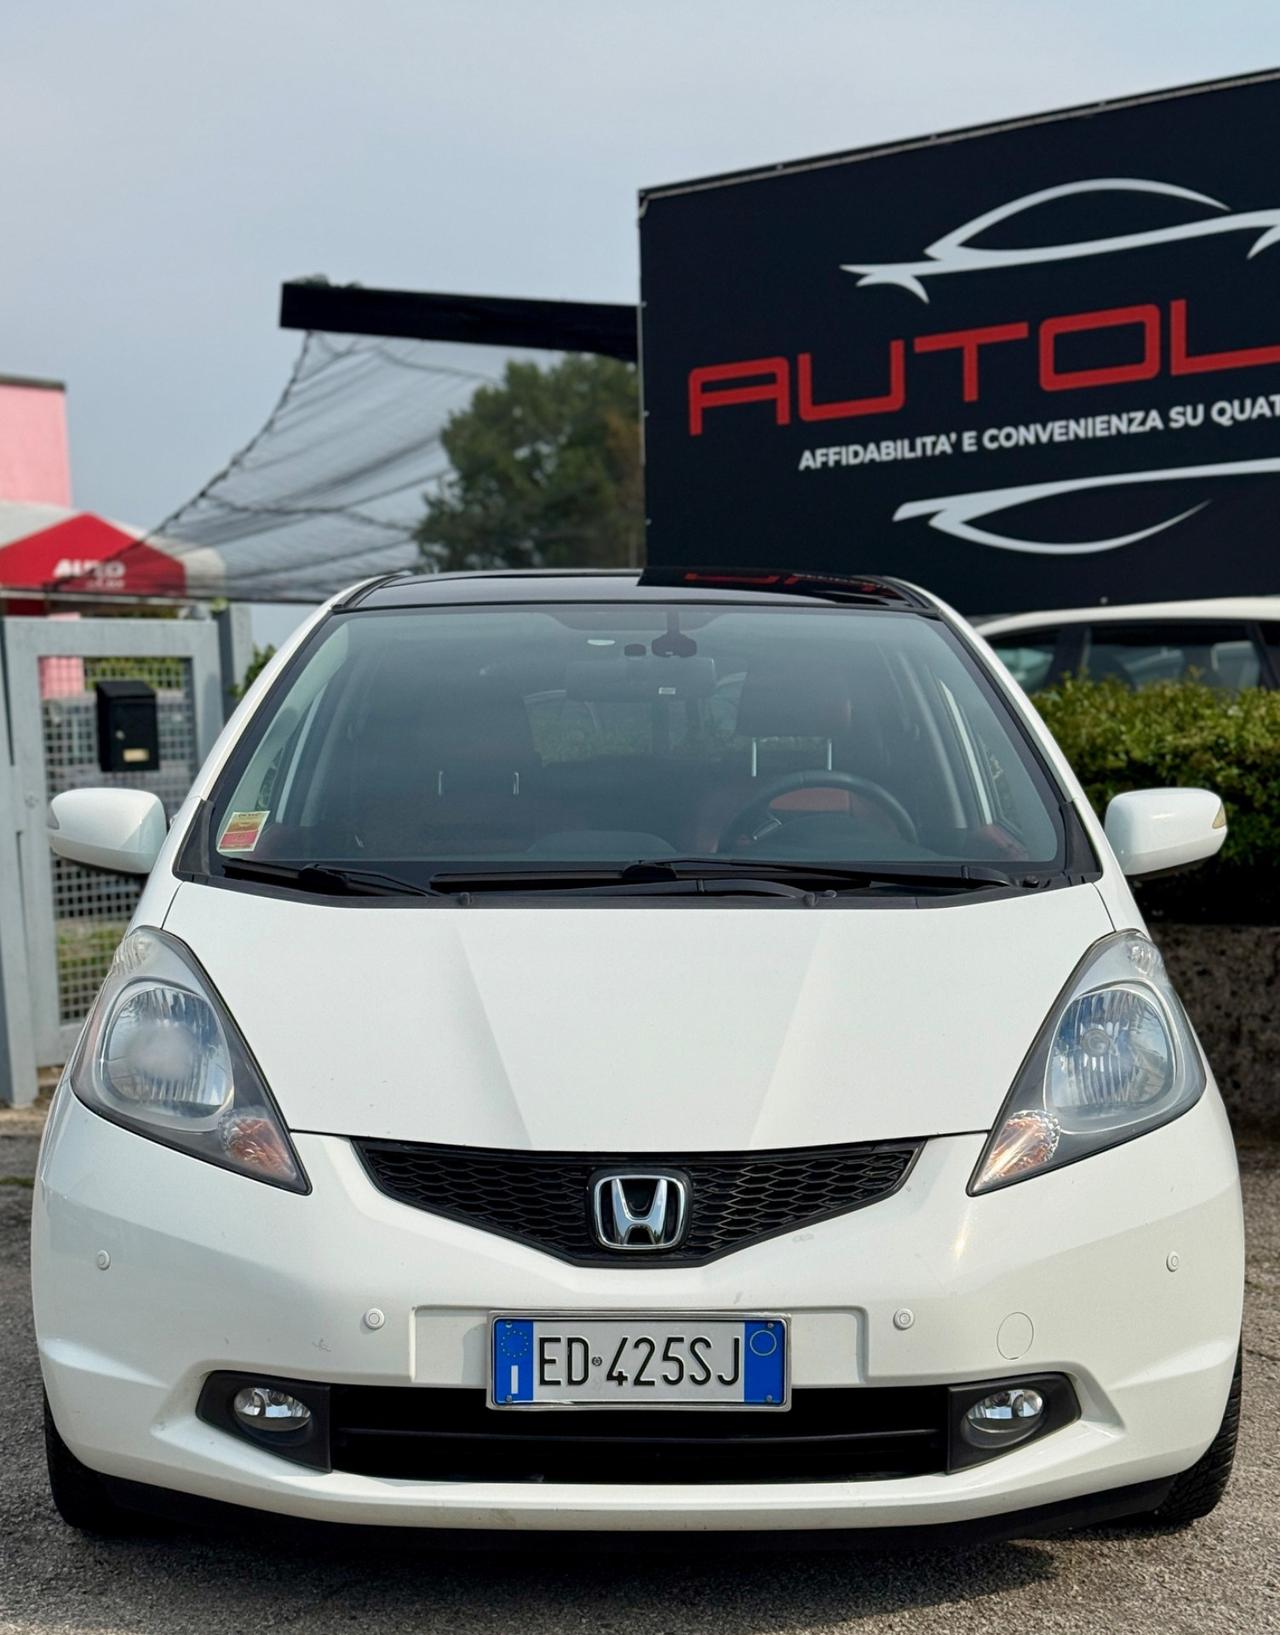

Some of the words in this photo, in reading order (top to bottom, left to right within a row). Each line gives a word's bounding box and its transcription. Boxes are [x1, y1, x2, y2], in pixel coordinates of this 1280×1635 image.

[962, 430, 978, 452] E
[982, 409, 1164, 450] CONVENIENZA
[1169, 404, 1204, 429] SU
[538, 1337, 590, 1386] ED
[606, 1337, 741, 1386] 425SJ
